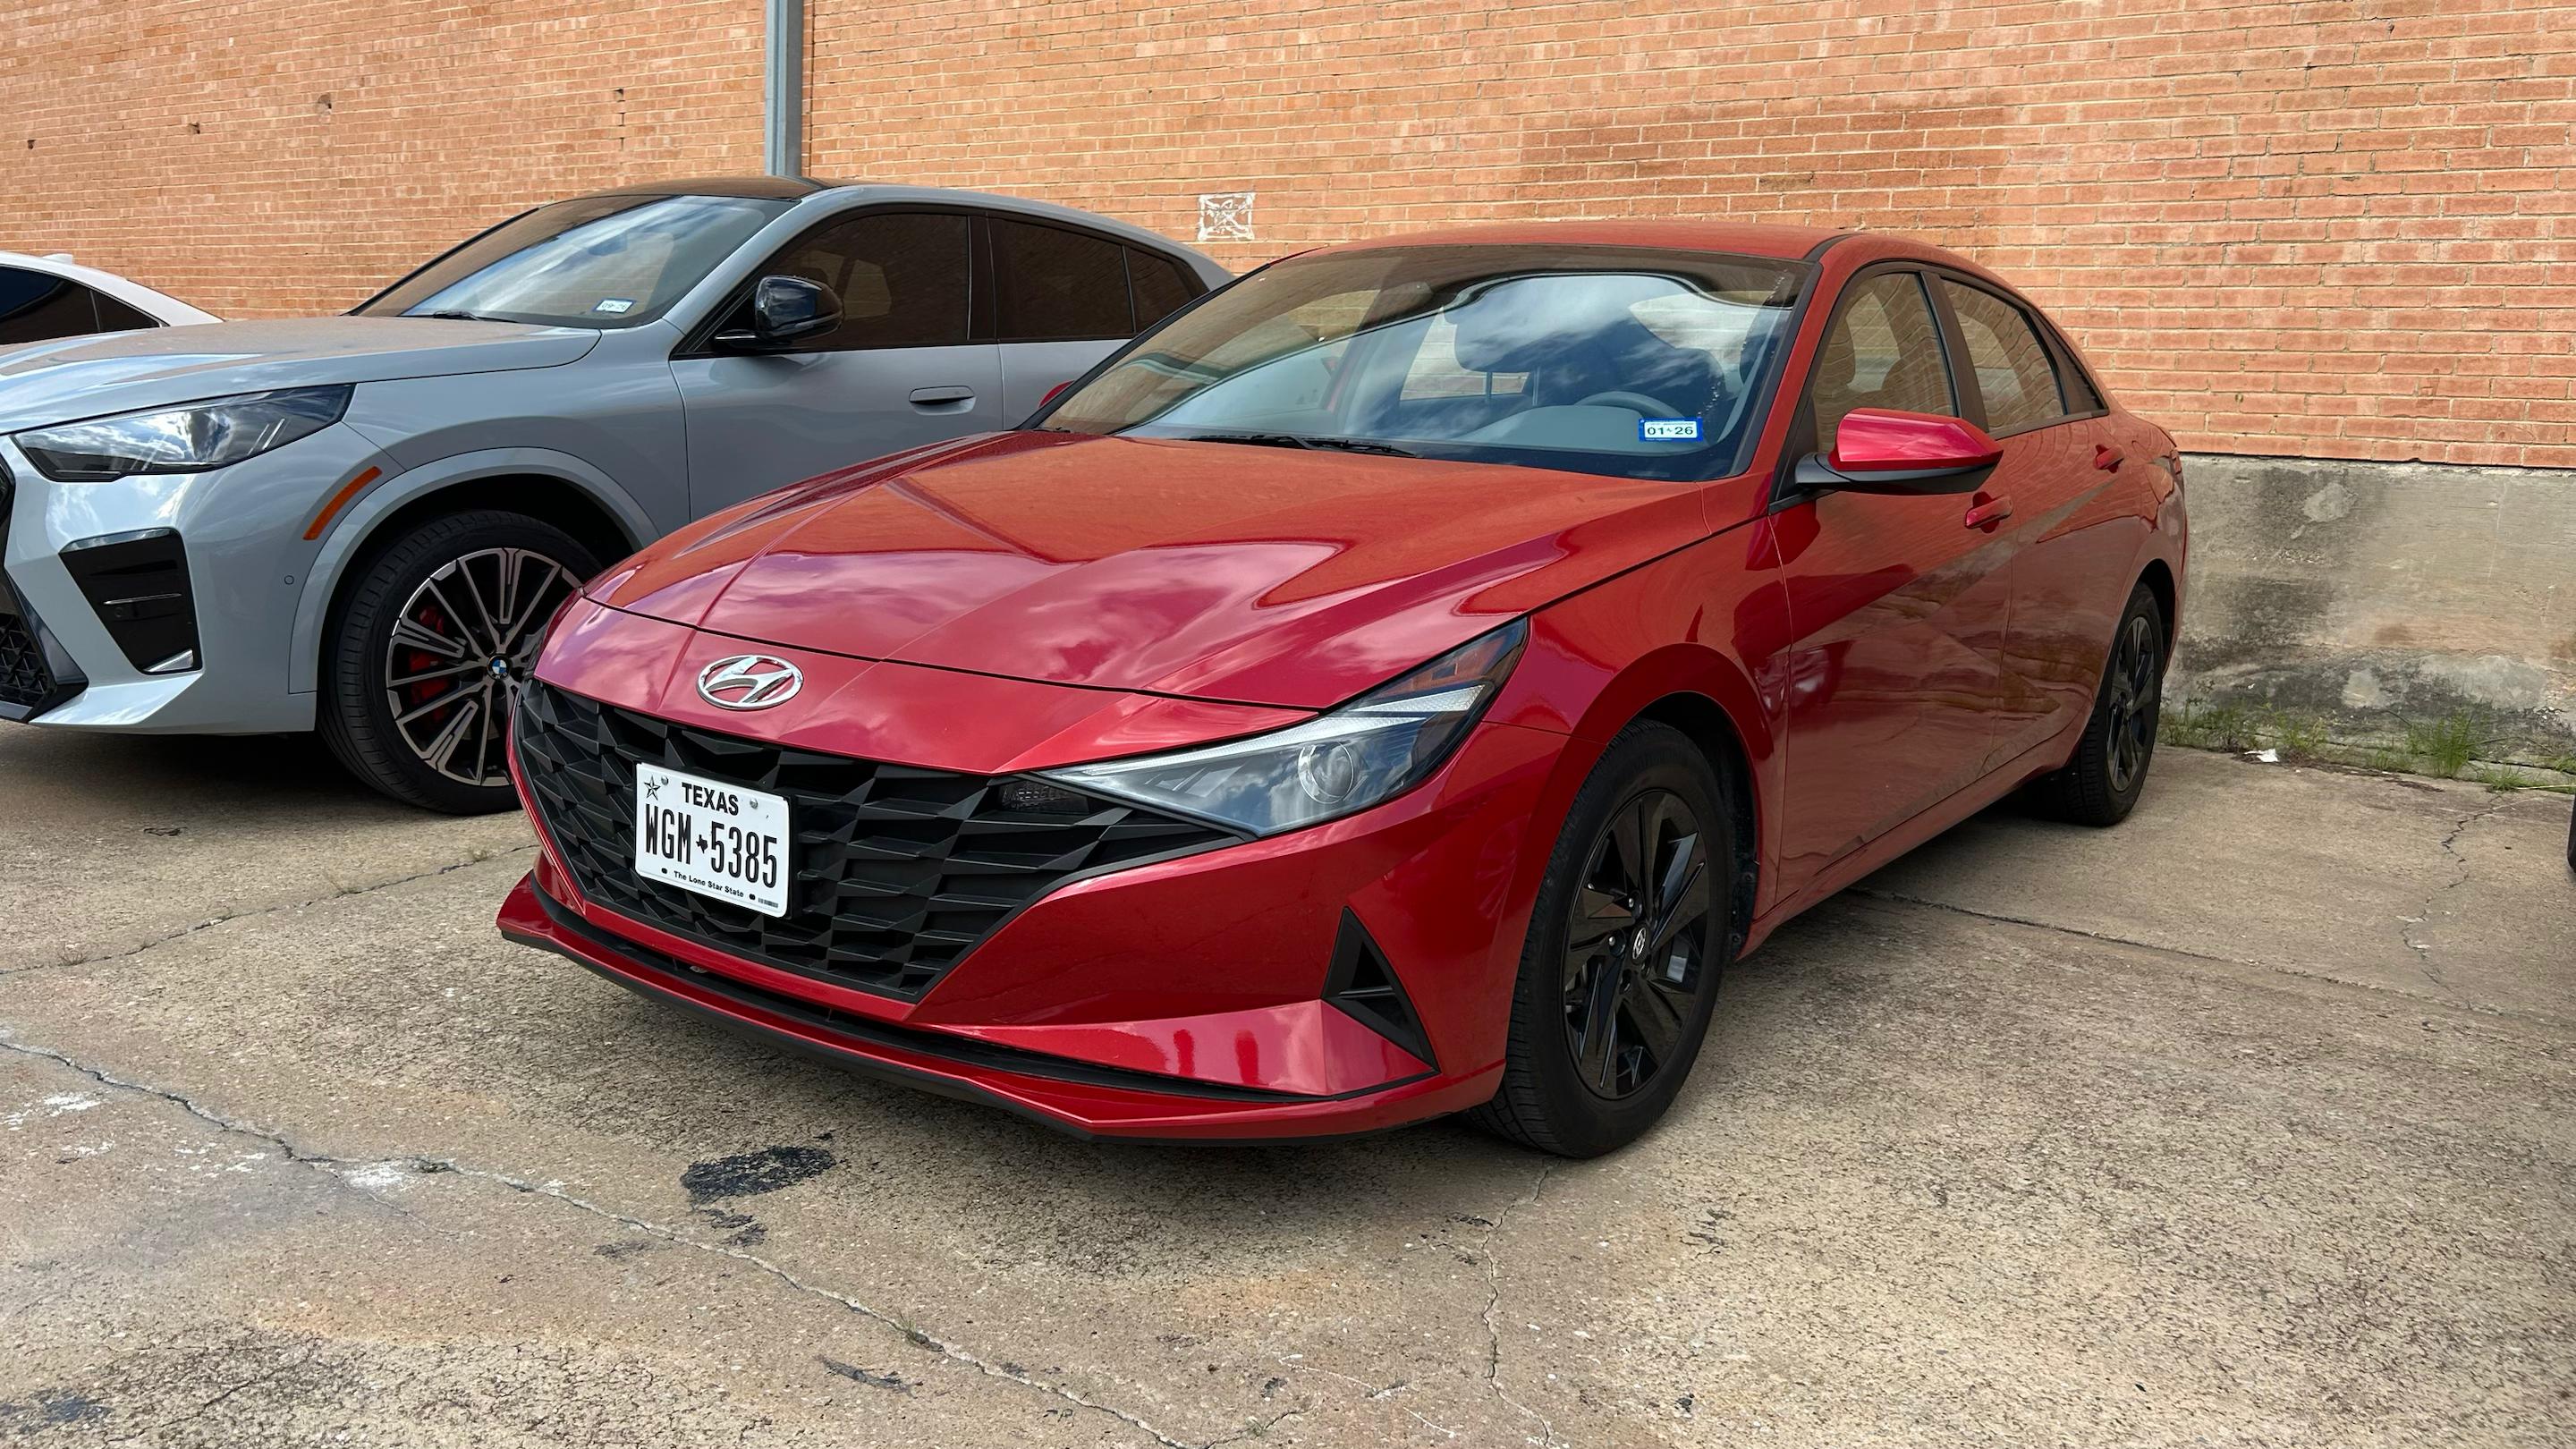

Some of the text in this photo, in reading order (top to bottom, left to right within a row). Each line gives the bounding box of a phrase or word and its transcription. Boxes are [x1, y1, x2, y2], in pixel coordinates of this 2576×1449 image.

[1648, 426, 1693, 436] 01 26
[682, 782, 739, 816] TEXAS
[646, 804, 778, 889] WGM 5385
[674, 869, 744, 898] The Lone Star State
